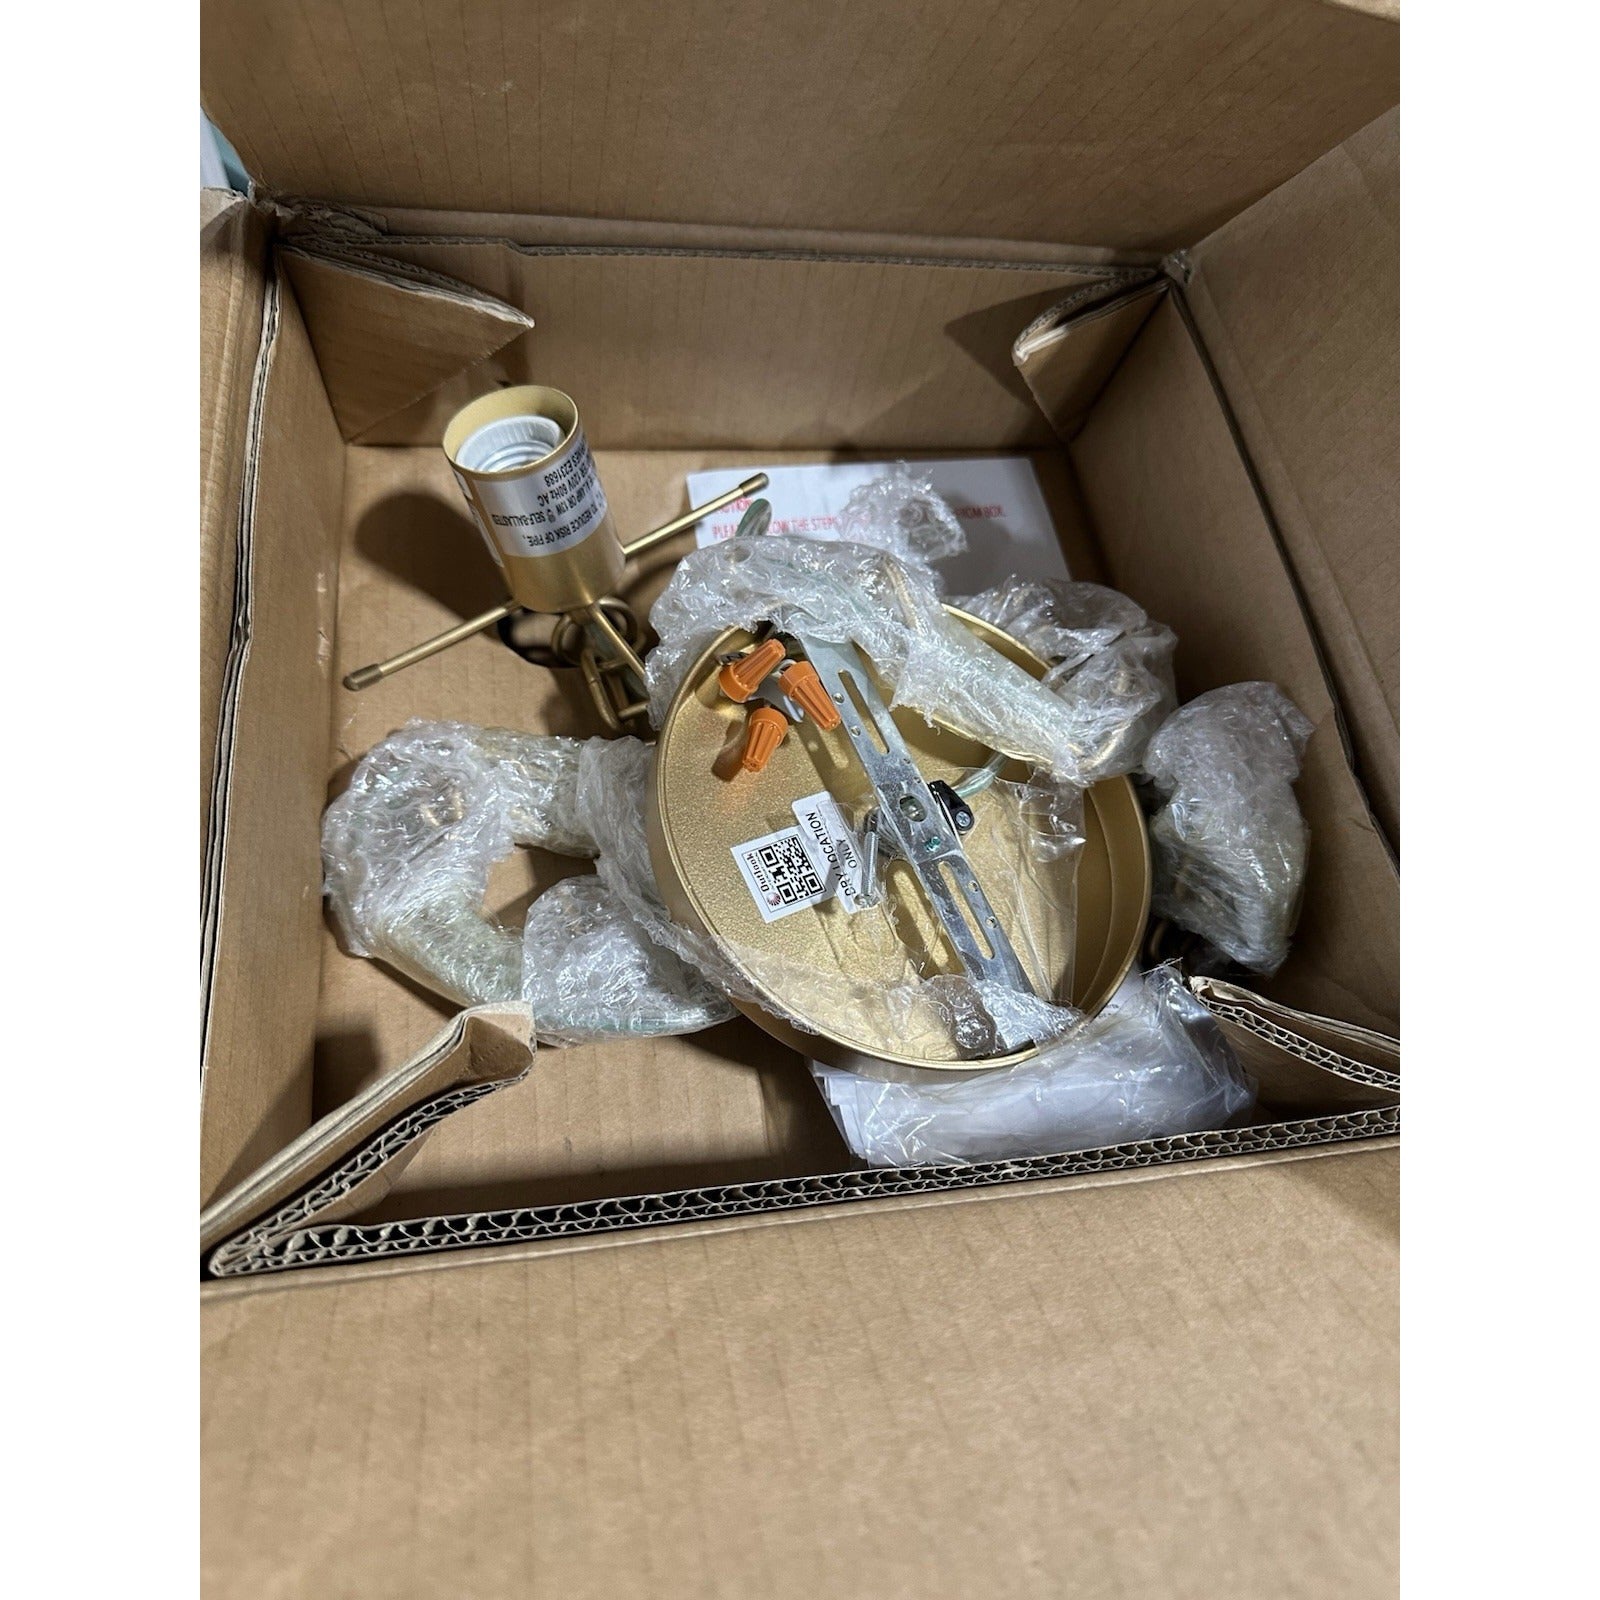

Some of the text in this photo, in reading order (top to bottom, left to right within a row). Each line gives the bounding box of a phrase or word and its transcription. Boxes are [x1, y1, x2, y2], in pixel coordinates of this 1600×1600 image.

[537, 492, 550, 507] AC
[570, 509, 593, 533] REDUCE
[544, 531, 555, 544] OF
[554, 524, 571, 539] RISK
[836, 838, 858, 869] ONLY
[836, 871, 856, 896] DRY
